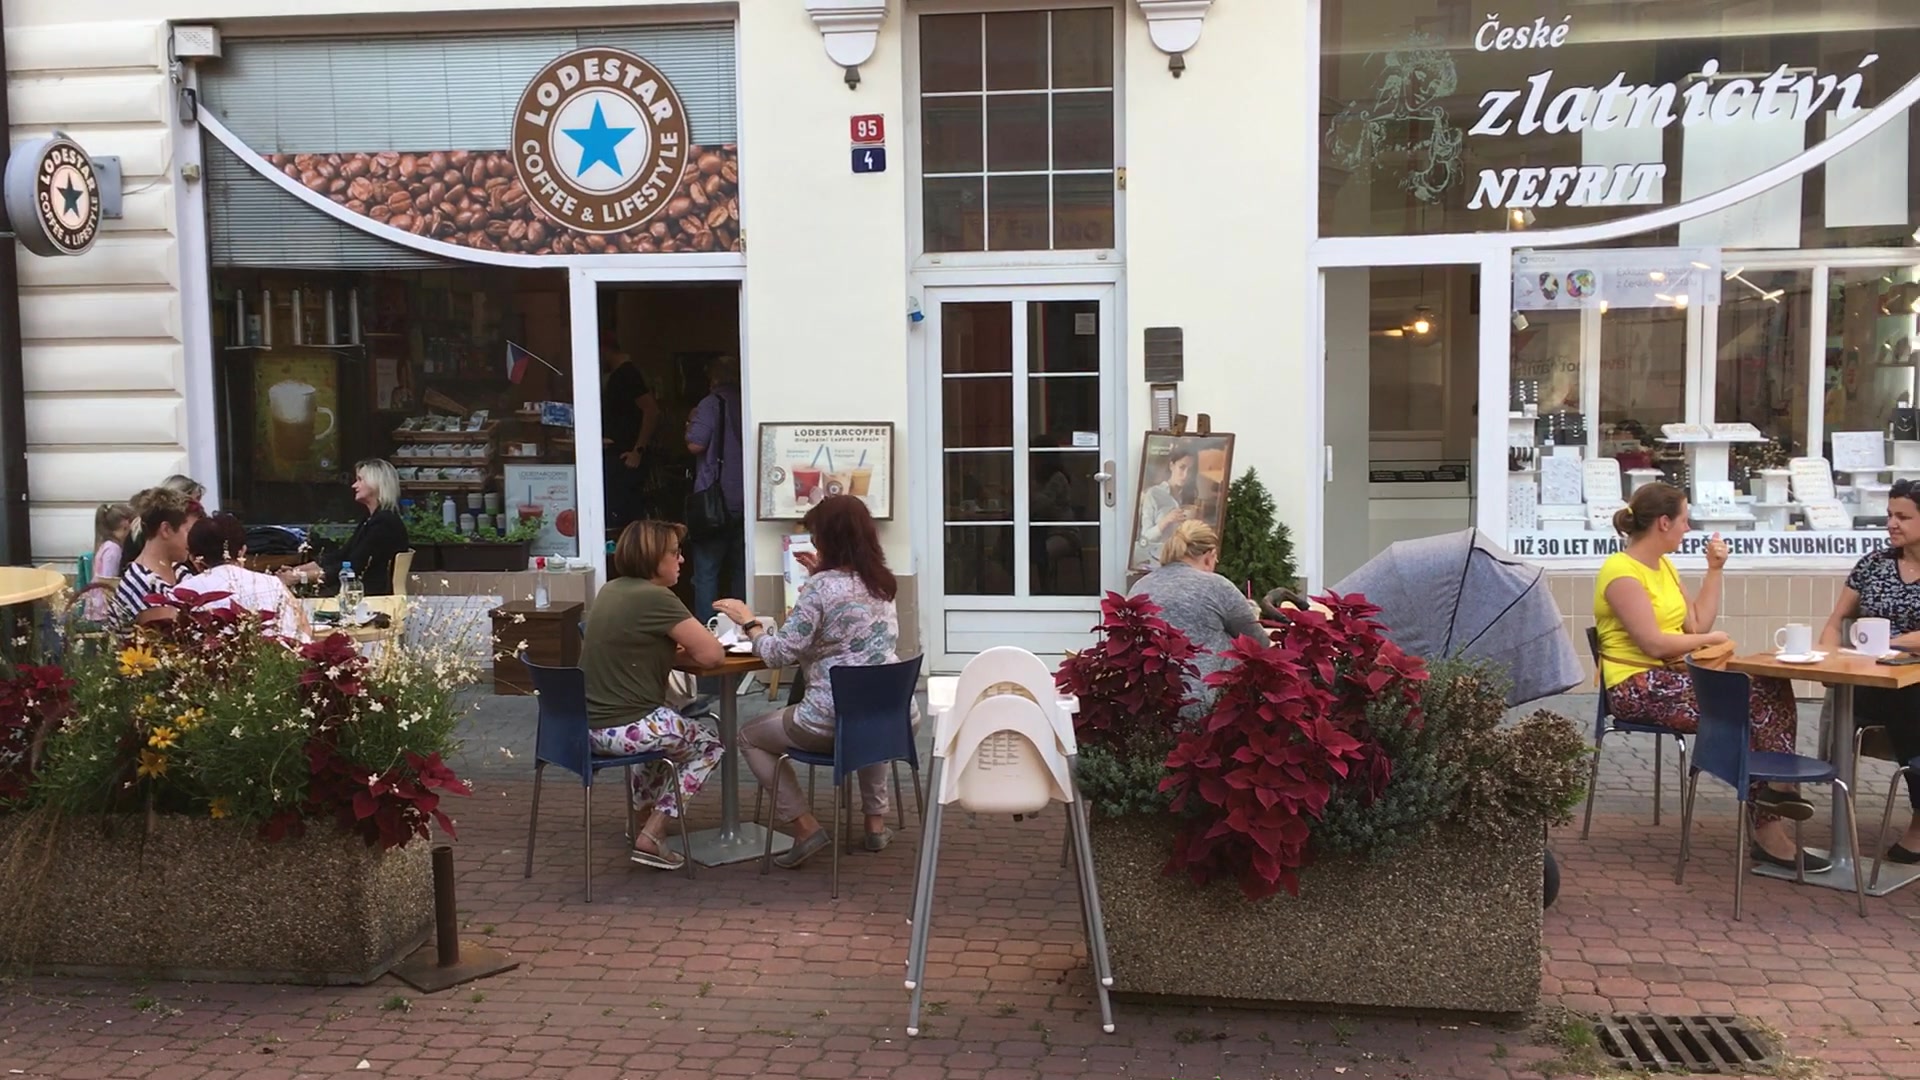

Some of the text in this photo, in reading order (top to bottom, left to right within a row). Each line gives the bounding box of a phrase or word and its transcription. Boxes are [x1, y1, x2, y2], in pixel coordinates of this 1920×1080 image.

[1474, 13, 1572, 52] České
[524, 57, 673, 126] LODESTAR
[1467, 53, 1880, 137] zlatnictví
[858, 120, 877, 138] 95
[40, 148, 95, 192] LODESTAR
[522, 132, 678, 223] COFFEE & LIFESTYLE
[864, 151, 873, 170] 4
[1467, 162, 1667, 211] NEFRIT
[40, 192, 98, 246] COFFEE & LIFESTYLE
[794, 428, 888, 437] LODESTARCOFFEE
[1513, 536, 1534, 555] JIŽ
[1538, 539, 1560, 555] 30
[1564, 539, 1589, 555] LET
[1768, 534, 1857, 554] SNUBNÍCH
